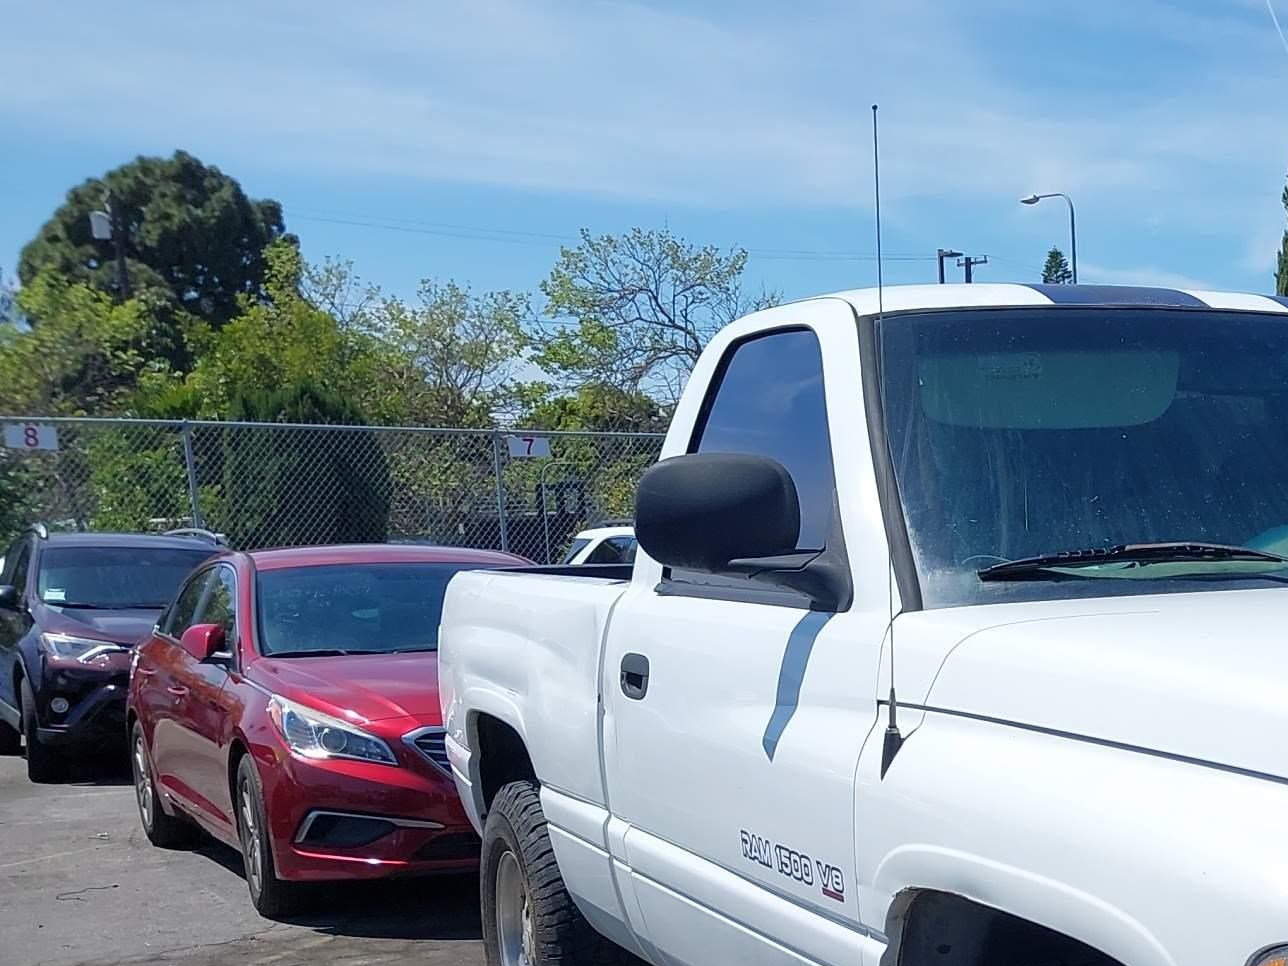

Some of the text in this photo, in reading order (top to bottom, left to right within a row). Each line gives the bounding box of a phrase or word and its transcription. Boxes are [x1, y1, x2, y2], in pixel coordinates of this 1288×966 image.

[24, 427, 38, 447] 8
[522, 438, 534, 455] 7
[740, 829, 845, 894] RAM 1500 V8
